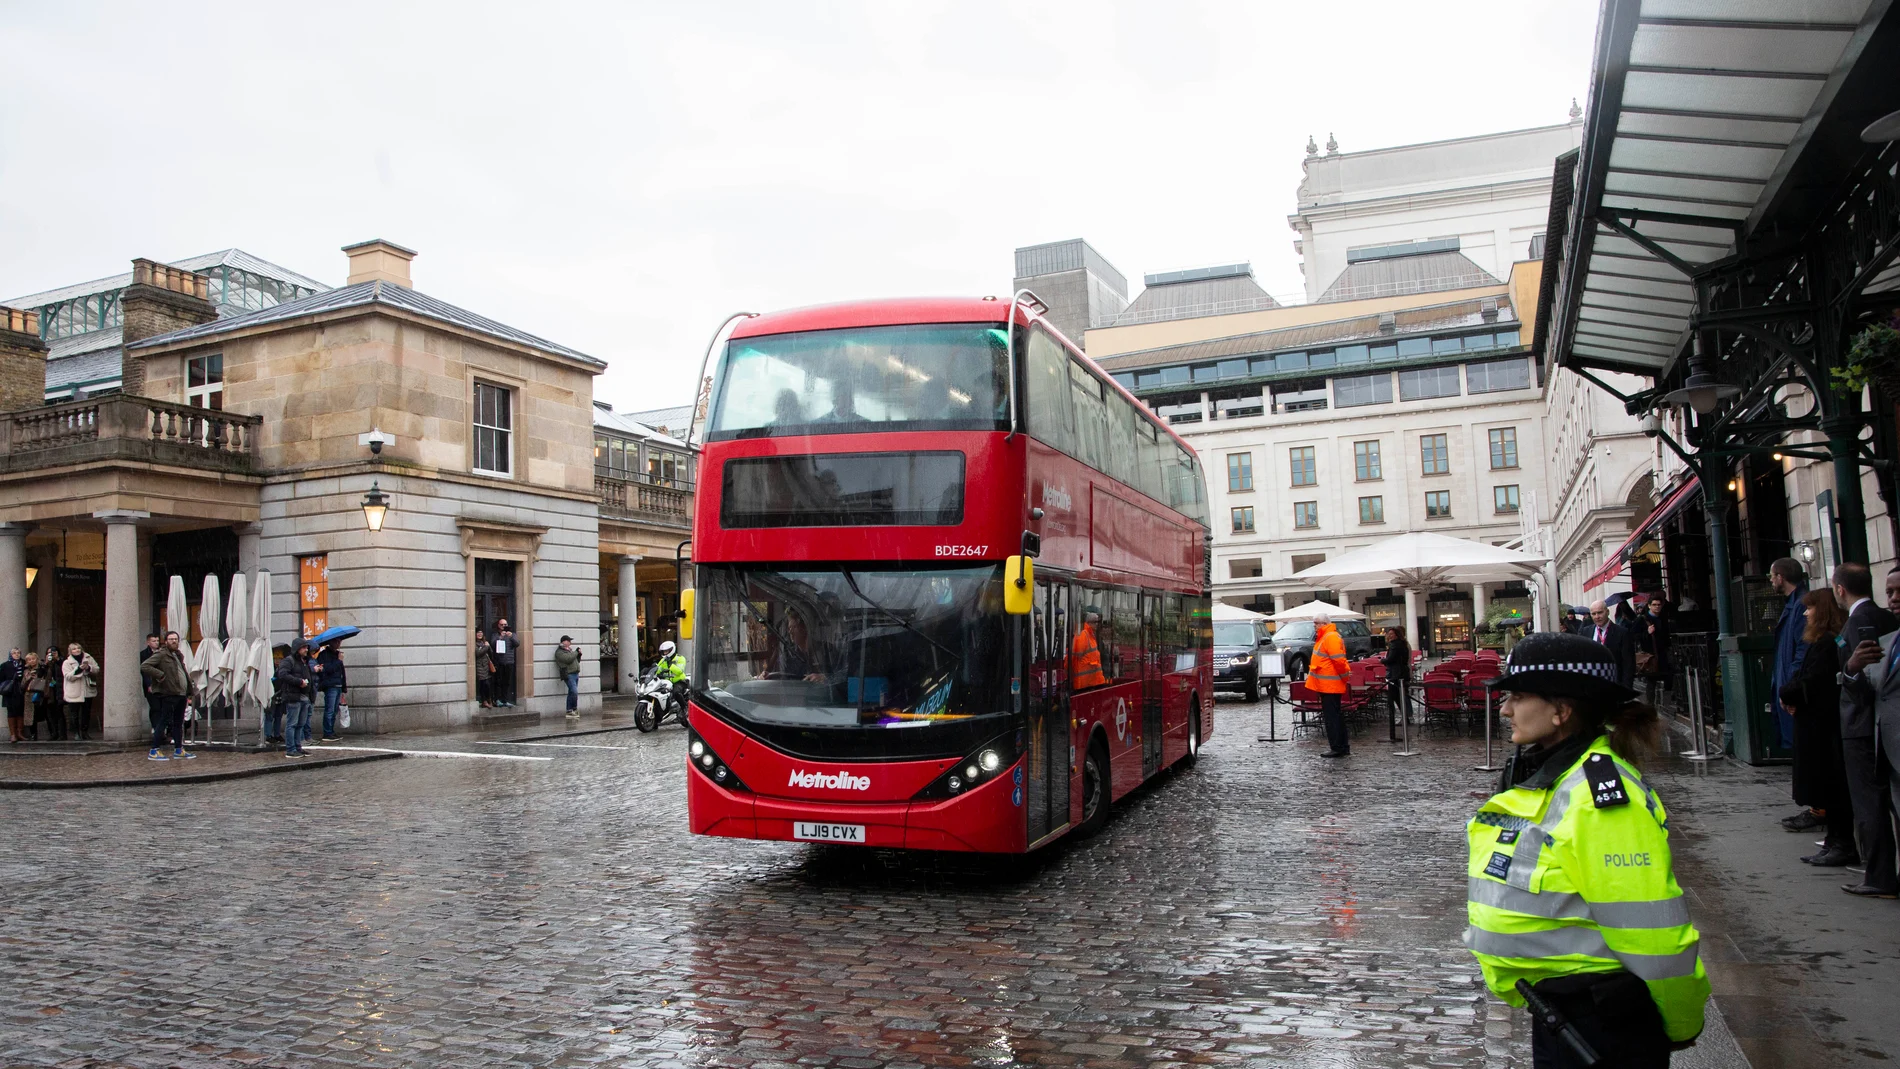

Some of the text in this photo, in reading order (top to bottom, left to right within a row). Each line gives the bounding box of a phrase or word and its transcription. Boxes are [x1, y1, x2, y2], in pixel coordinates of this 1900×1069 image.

[1042, 479, 1072, 512] Metroline
[935, 545, 988, 556] BDE2647
[788, 768, 871, 791] Metroline
[1598, 780, 1616, 790] AW
[1596, 790, 1622, 803] 4541
[801, 824, 857, 840] LJ19 CVX
[1604, 853, 1651, 867] POLICE
